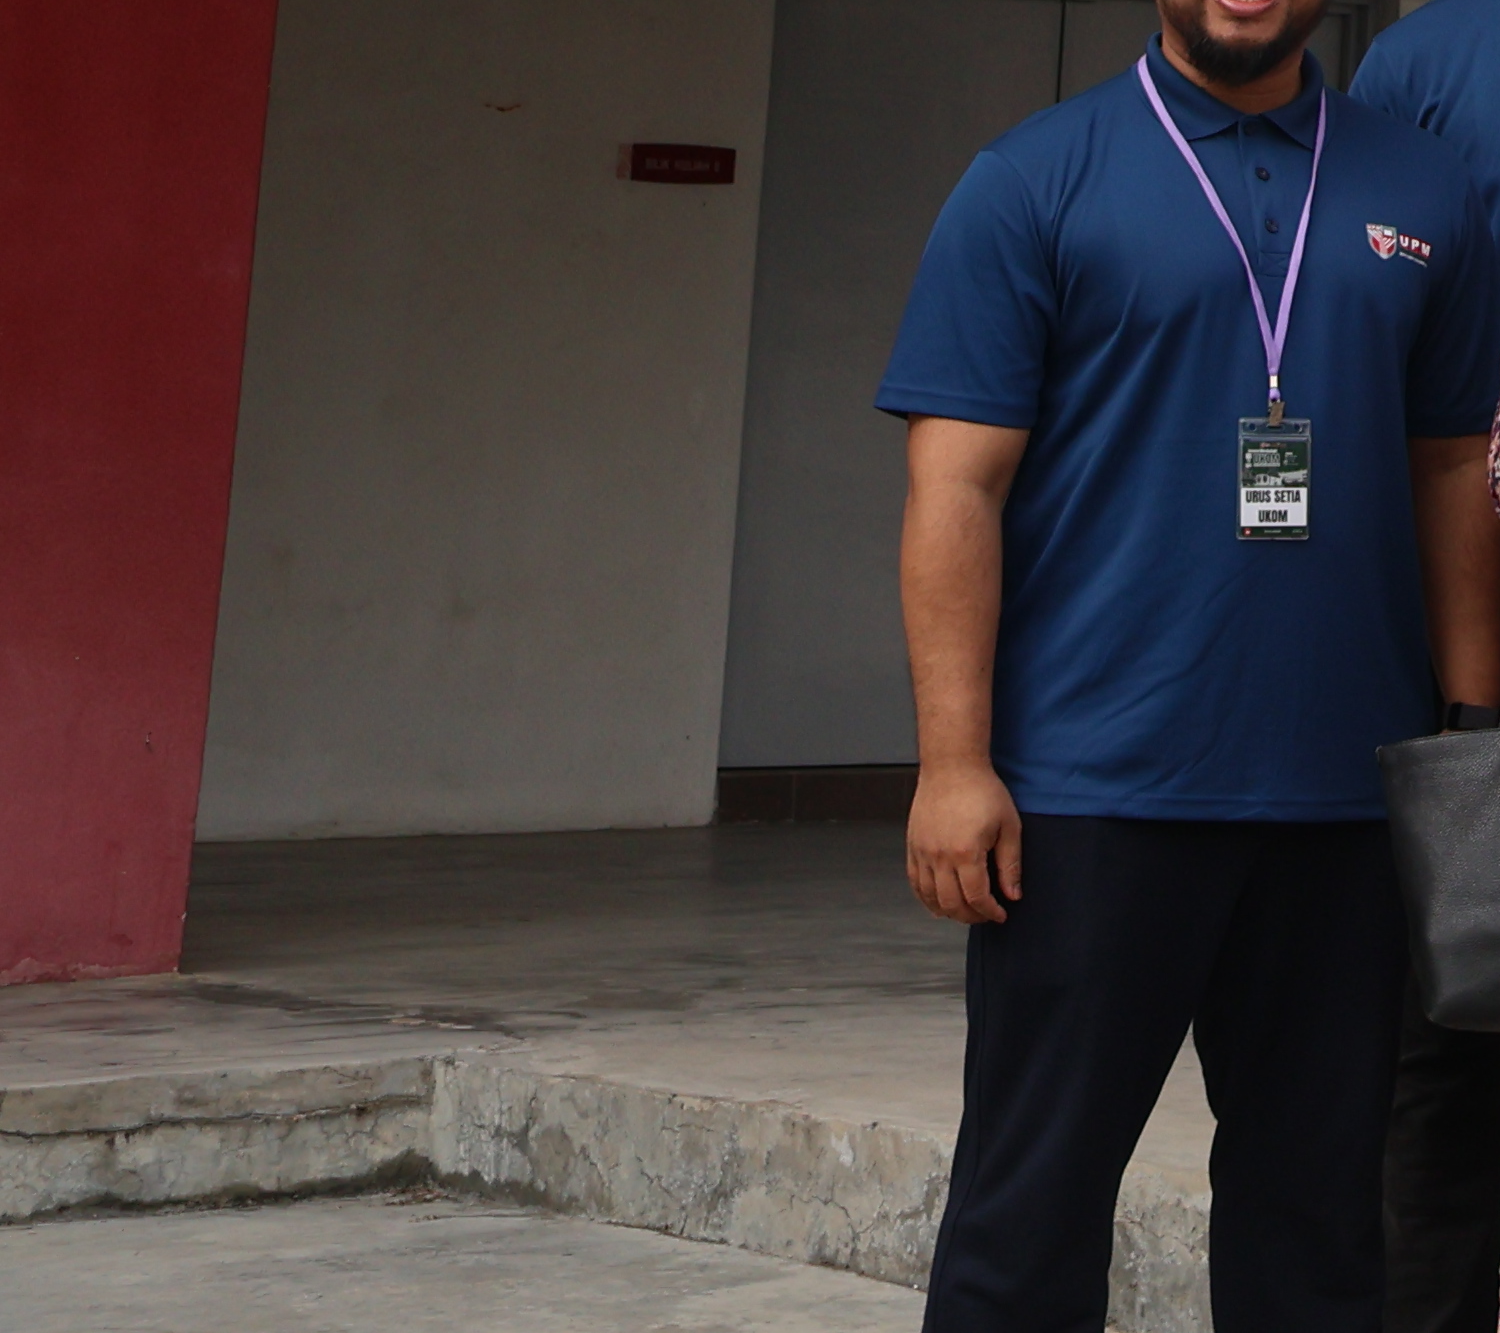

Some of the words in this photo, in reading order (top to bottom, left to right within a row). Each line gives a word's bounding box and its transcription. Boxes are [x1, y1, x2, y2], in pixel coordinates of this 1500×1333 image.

[1399, 234, 1432, 257] UPM
[1245, 489, 1271, 504] URUS
[1274, 489, 1302, 504] SETIA
[1258, 509, 1289, 523] UKOM
